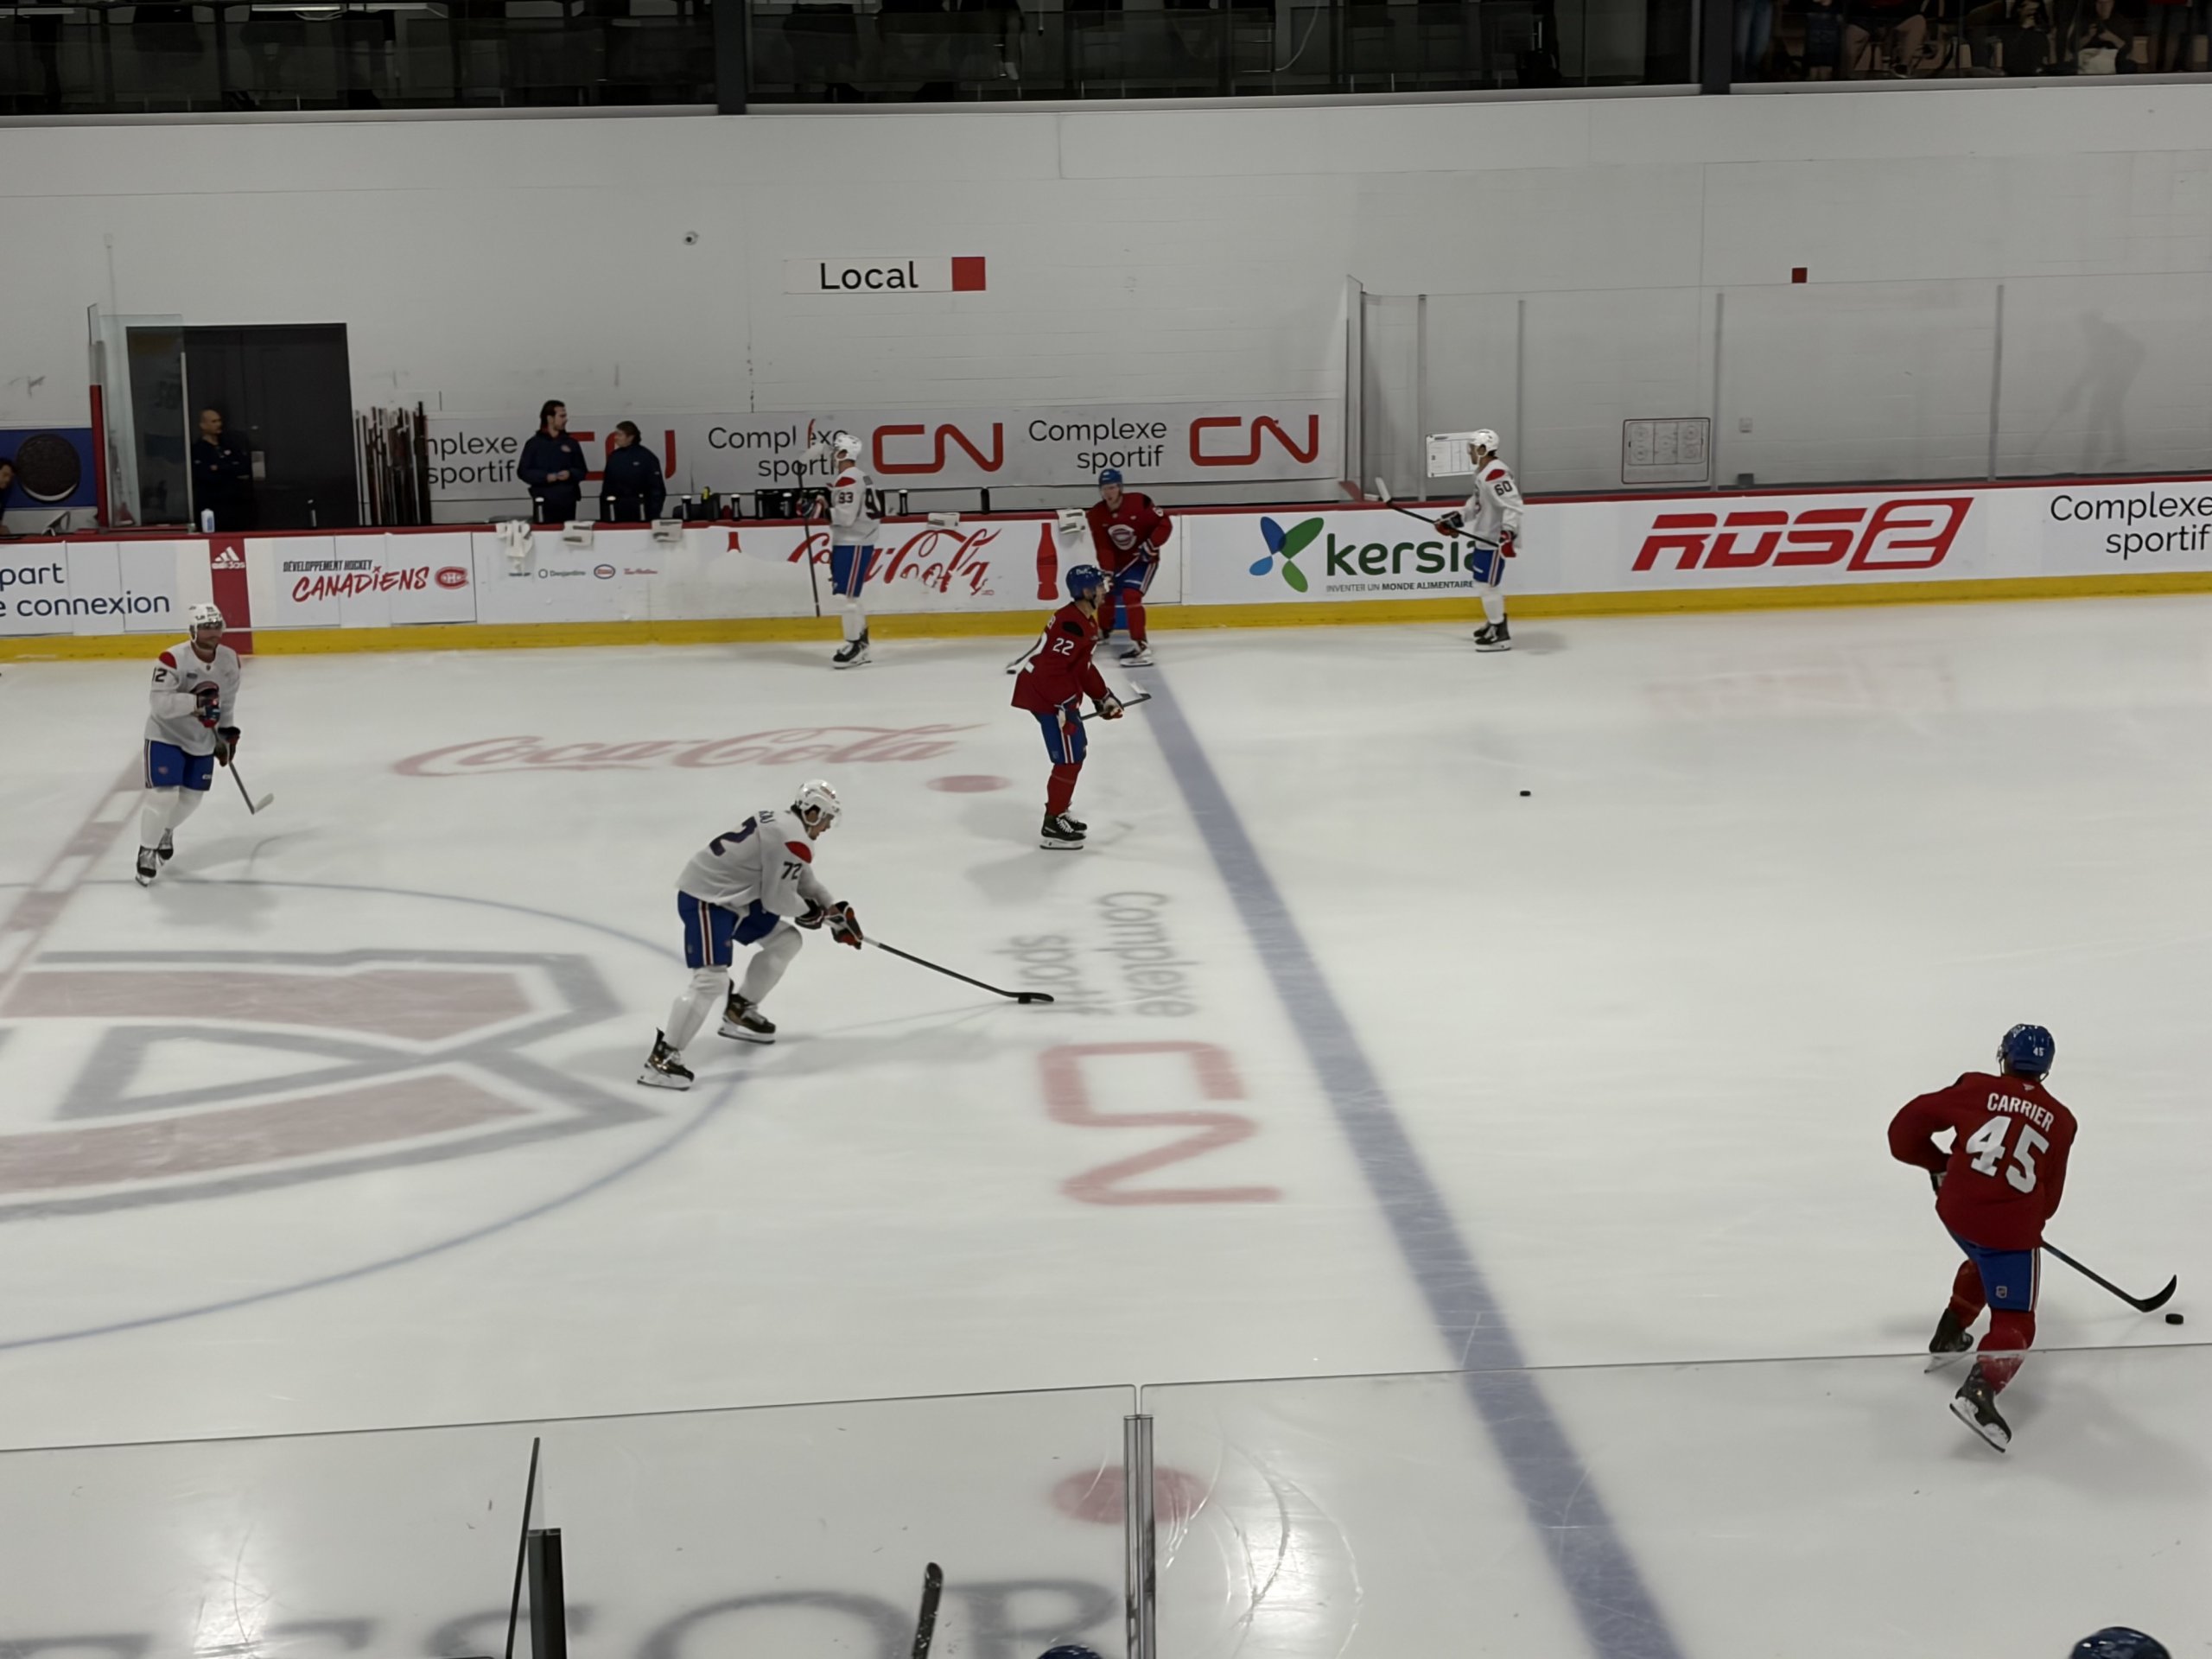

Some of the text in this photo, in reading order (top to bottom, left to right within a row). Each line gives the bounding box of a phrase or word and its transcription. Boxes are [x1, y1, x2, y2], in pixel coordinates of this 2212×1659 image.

[821, 261, 918, 289] Local
[1029, 417, 1166, 445] Complexe
[1190, 415, 1319, 467] CN
[873, 423, 1003, 474] CN
[1077, 445, 1164, 474] sportif
[1494, 480, 1513, 496] 60
[2050, 491, 2212, 525] Complexe
[2106, 524, 2212, 560] sportif
[0, 563, 65, 591] part
[1326, 583, 1365, 593] INVENTER
[1382, 582, 1415, 591] MONDE
[1417, 580, 1473, 589] ALIMENTAIRE
[17, 591, 170, 617] connexion
[1052, 638, 1074, 655] 22
[391, 723, 988, 778] Coca-Cola
[781, 861, 802, 880] 72
[1096, 891, 1202, 1018] Complexe
[2032, 1046, 2044, 1057] 45
[1037, 1039, 1284, 1208] CN
[1987, 1092, 2055, 1132] CARRIER
[1966, 1116, 2050, 1193] 45
